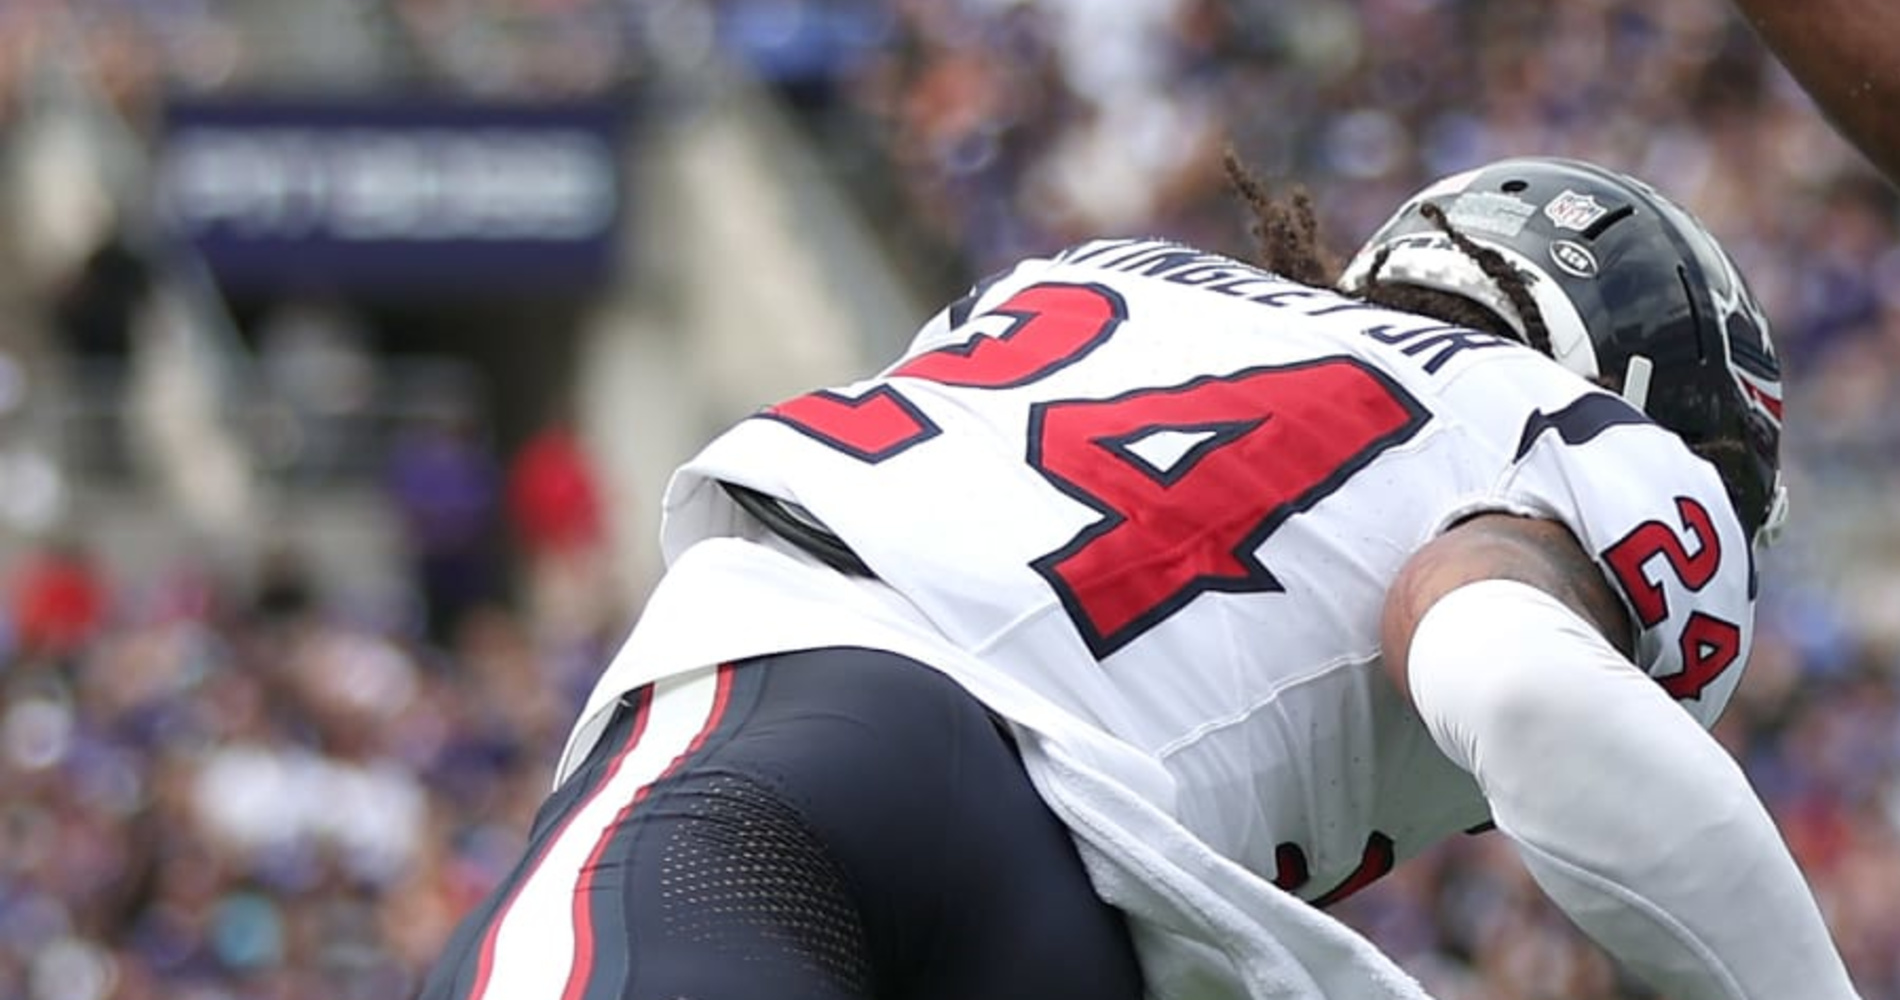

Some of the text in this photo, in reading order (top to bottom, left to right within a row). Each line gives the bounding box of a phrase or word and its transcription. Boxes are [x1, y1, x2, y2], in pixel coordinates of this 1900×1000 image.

[1360, 324, 1518, 376] JR
[752, 280, 1434, 662] 24
[1600, 496, 1741, 702] 24
